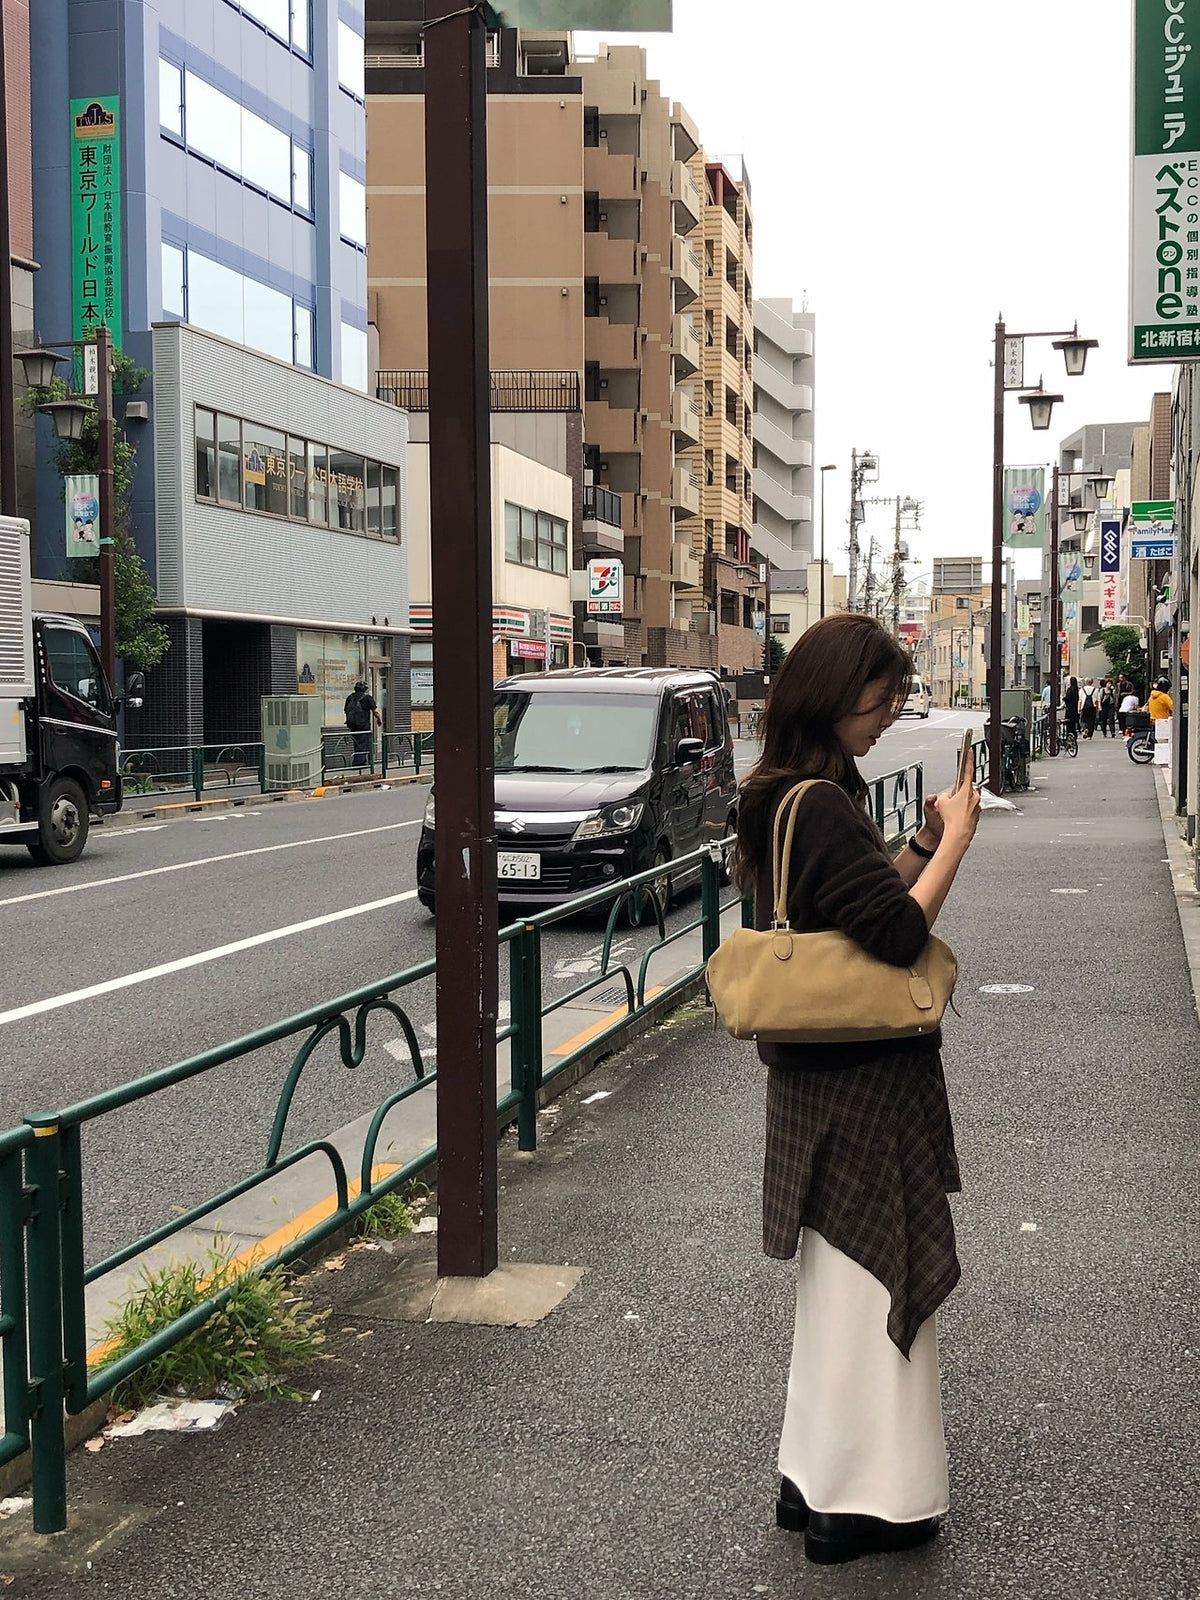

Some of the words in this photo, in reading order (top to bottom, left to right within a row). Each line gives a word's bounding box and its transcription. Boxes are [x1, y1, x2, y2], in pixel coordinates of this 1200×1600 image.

[102, 143, 113, 187] 財団法人
[1186, 159, 1199, 317] ECCの個別指導塾
[1133, 526, 1172, 537] FamilyMar
[1103, 529, 1118, 565] GEO
[1135, 546, 1147, 558] 酒
[1150, 547, 1173, 557] たばこ
[502, 863, 537, 878] 65-13
